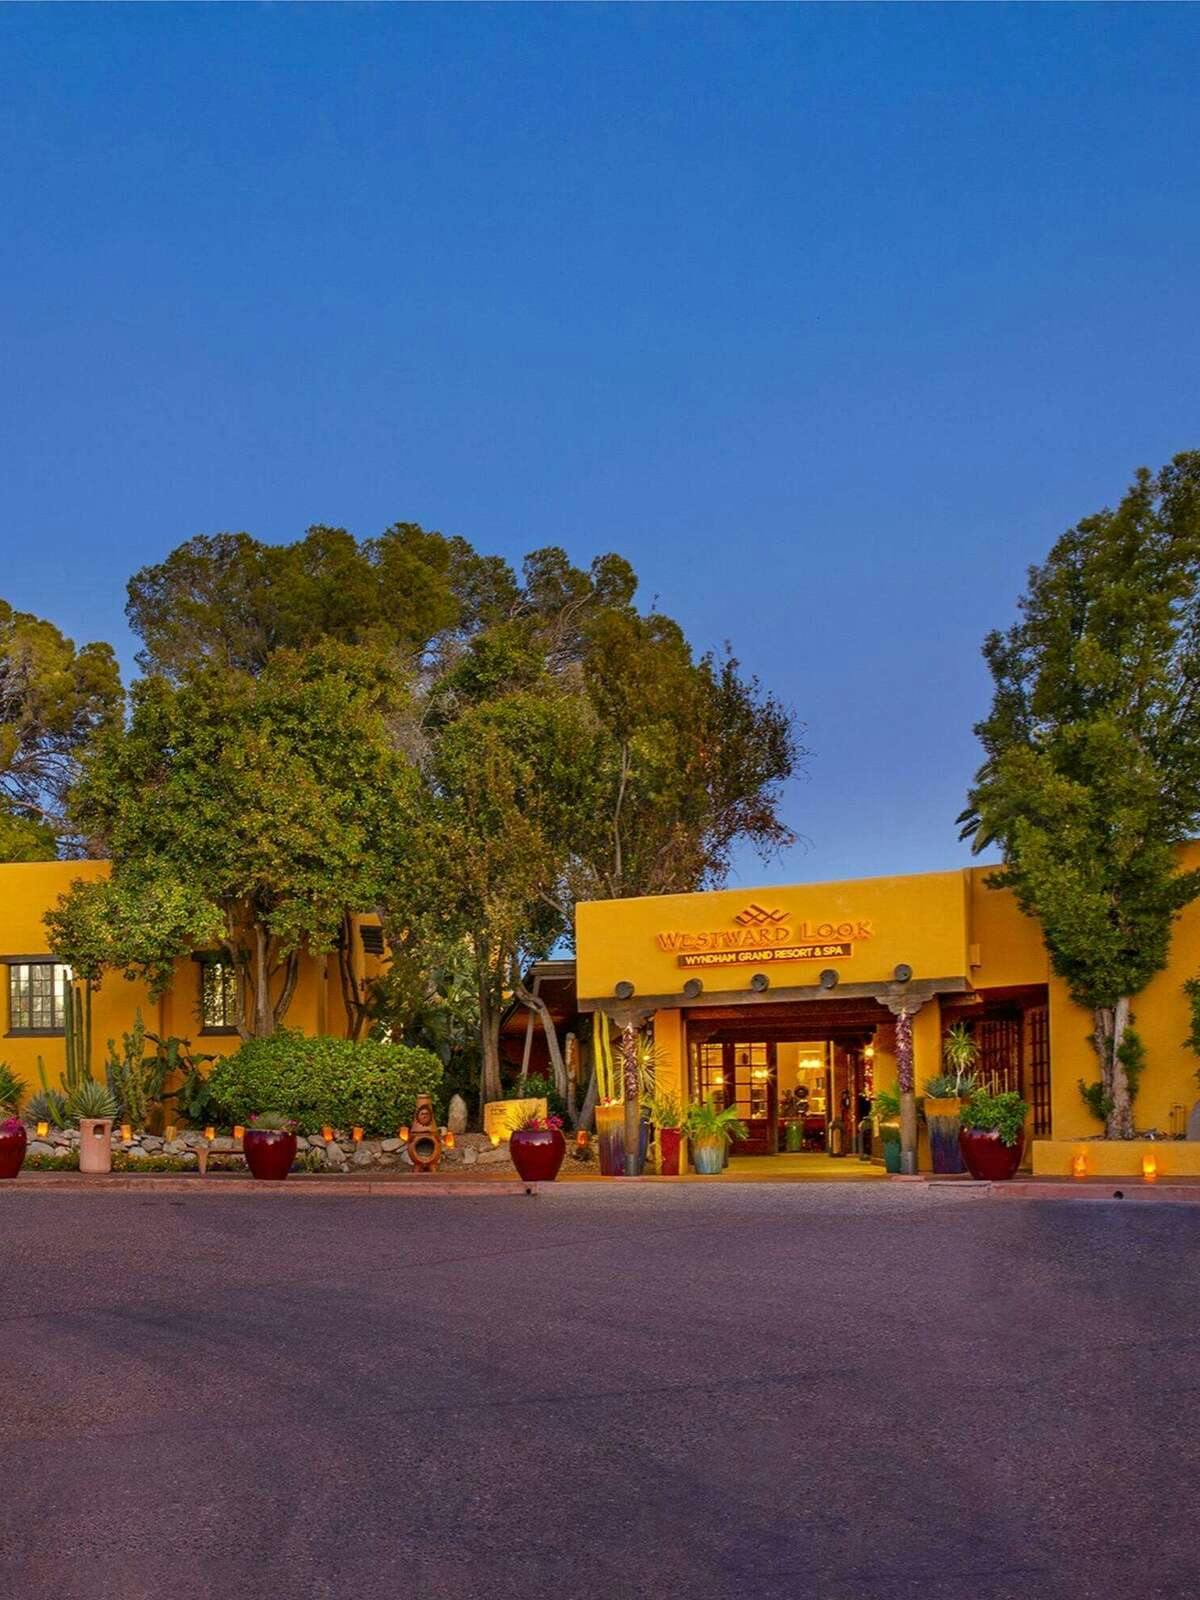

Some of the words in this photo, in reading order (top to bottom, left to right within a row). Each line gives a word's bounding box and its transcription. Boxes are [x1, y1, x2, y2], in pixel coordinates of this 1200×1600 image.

[657, 926, 790, 951] WESTWARD
[801, 919, 873, 941] LOOK
[685, 953, 736, 965] WYNDHAM
[738, 950, 773, 962] GRAND
[774, 947, 813, 959] RESORT
[814, 947, 821, 957] &
[823, 945, 843, 956] SPA
